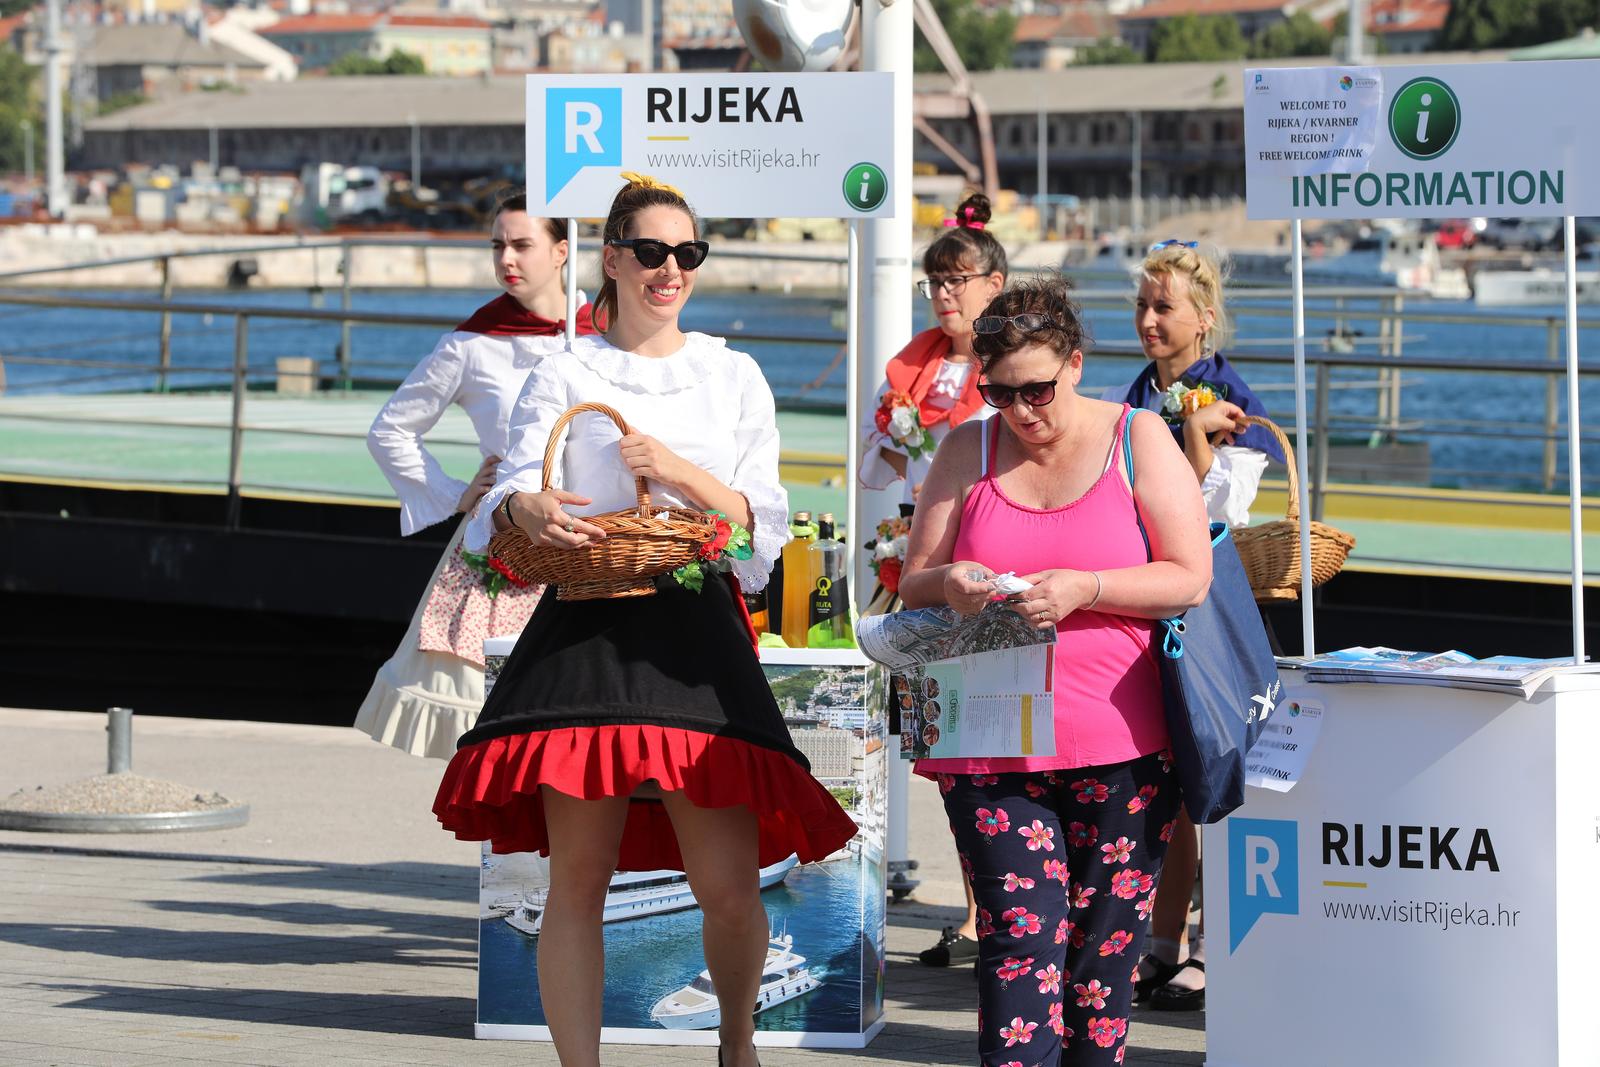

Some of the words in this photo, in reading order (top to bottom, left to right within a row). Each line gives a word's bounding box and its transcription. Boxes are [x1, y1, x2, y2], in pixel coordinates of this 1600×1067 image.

[647, 86, 804, 124] RIJEKA
[1280, 101, 1330, 111] WELCOME
[1333, 100, 1347, 110] TO
[564, 101, 605, 154] R
[1268, 118, 1301, 130] RIJEKA
[1310, 117, 1359, 128] KVARNER
[1290, 133, 1329, 144] REGION
[647, 148, 821, 173] www.visitRijeka.hr
[1259, 151, 1282, 161] FREE
[1284, 150, 1332, 161] WELCOME
[1332, 148, 1364, 159] DRINK
[1292, 170, 1564, 208] INFORMATION
[1259, 765, 1292, 780] DRINK
[1322, 822, 1500, 873] RIJEKA
[1245, 835, 1282, 898] R
[1323, 899, 1521, 931] www.visitRijeka.hr
